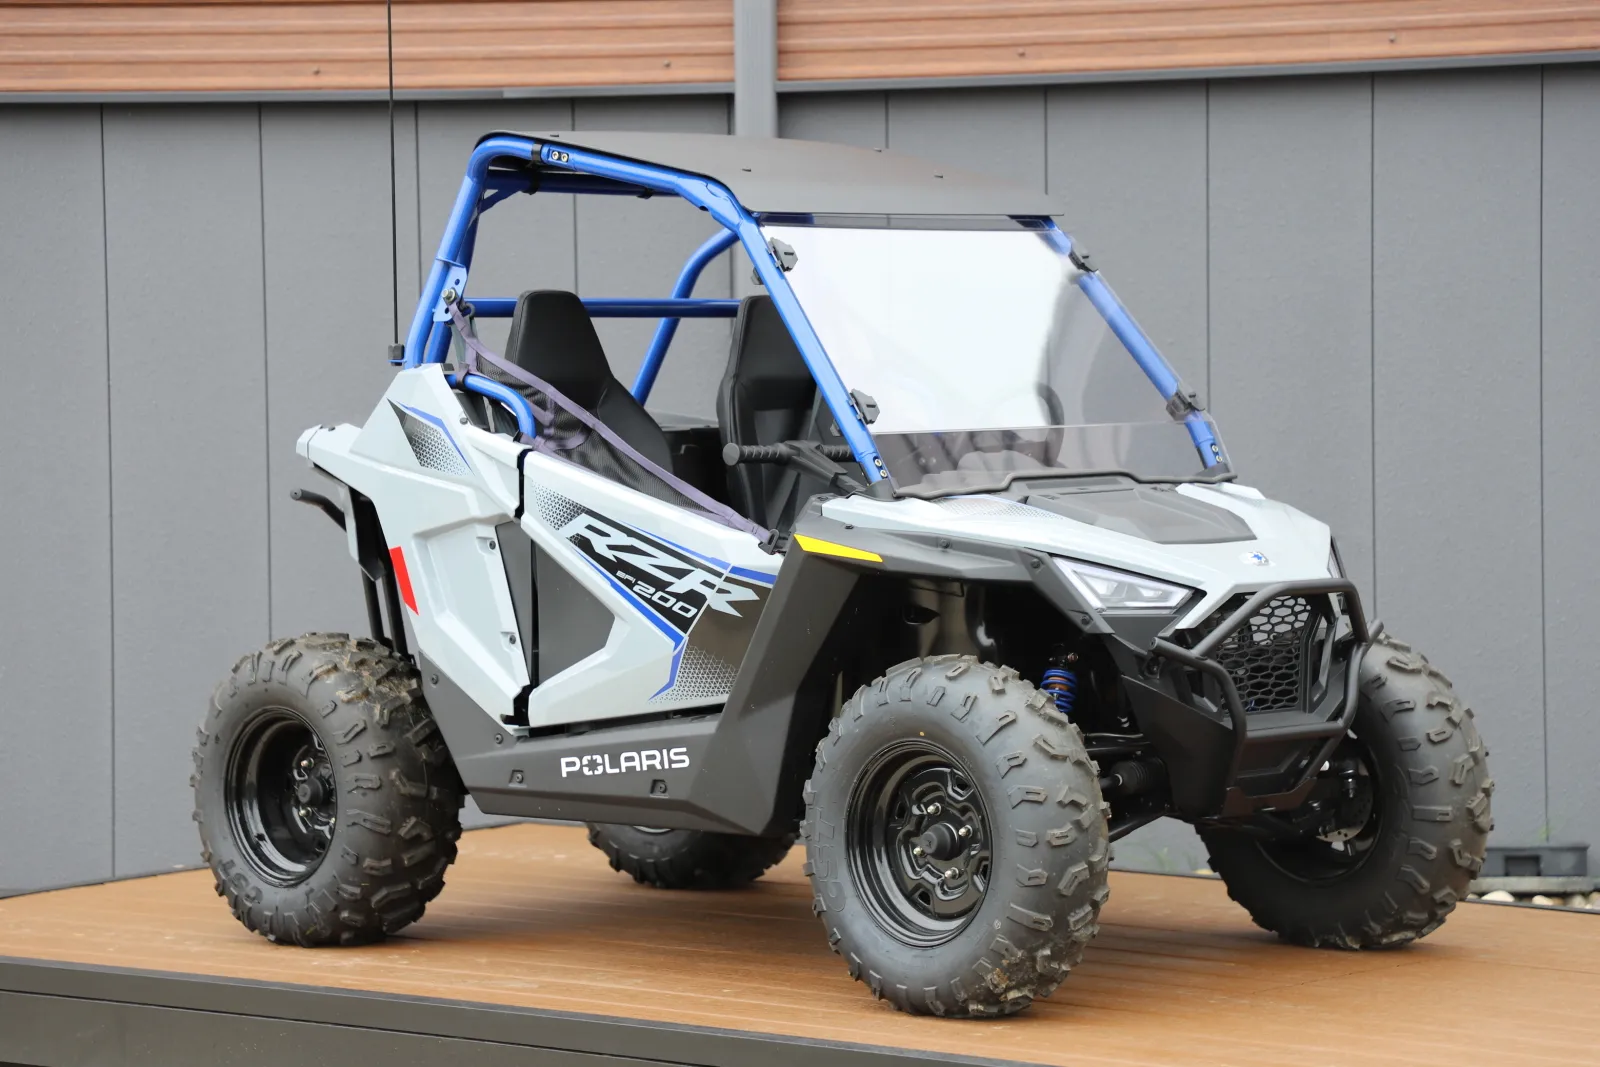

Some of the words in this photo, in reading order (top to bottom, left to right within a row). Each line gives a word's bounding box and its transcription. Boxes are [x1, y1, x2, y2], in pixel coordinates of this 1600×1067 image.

[560, 514, 760, 618] RZR
[632, 580, 698, 618] 200
[560, 747, 690, 777] POLARIS
